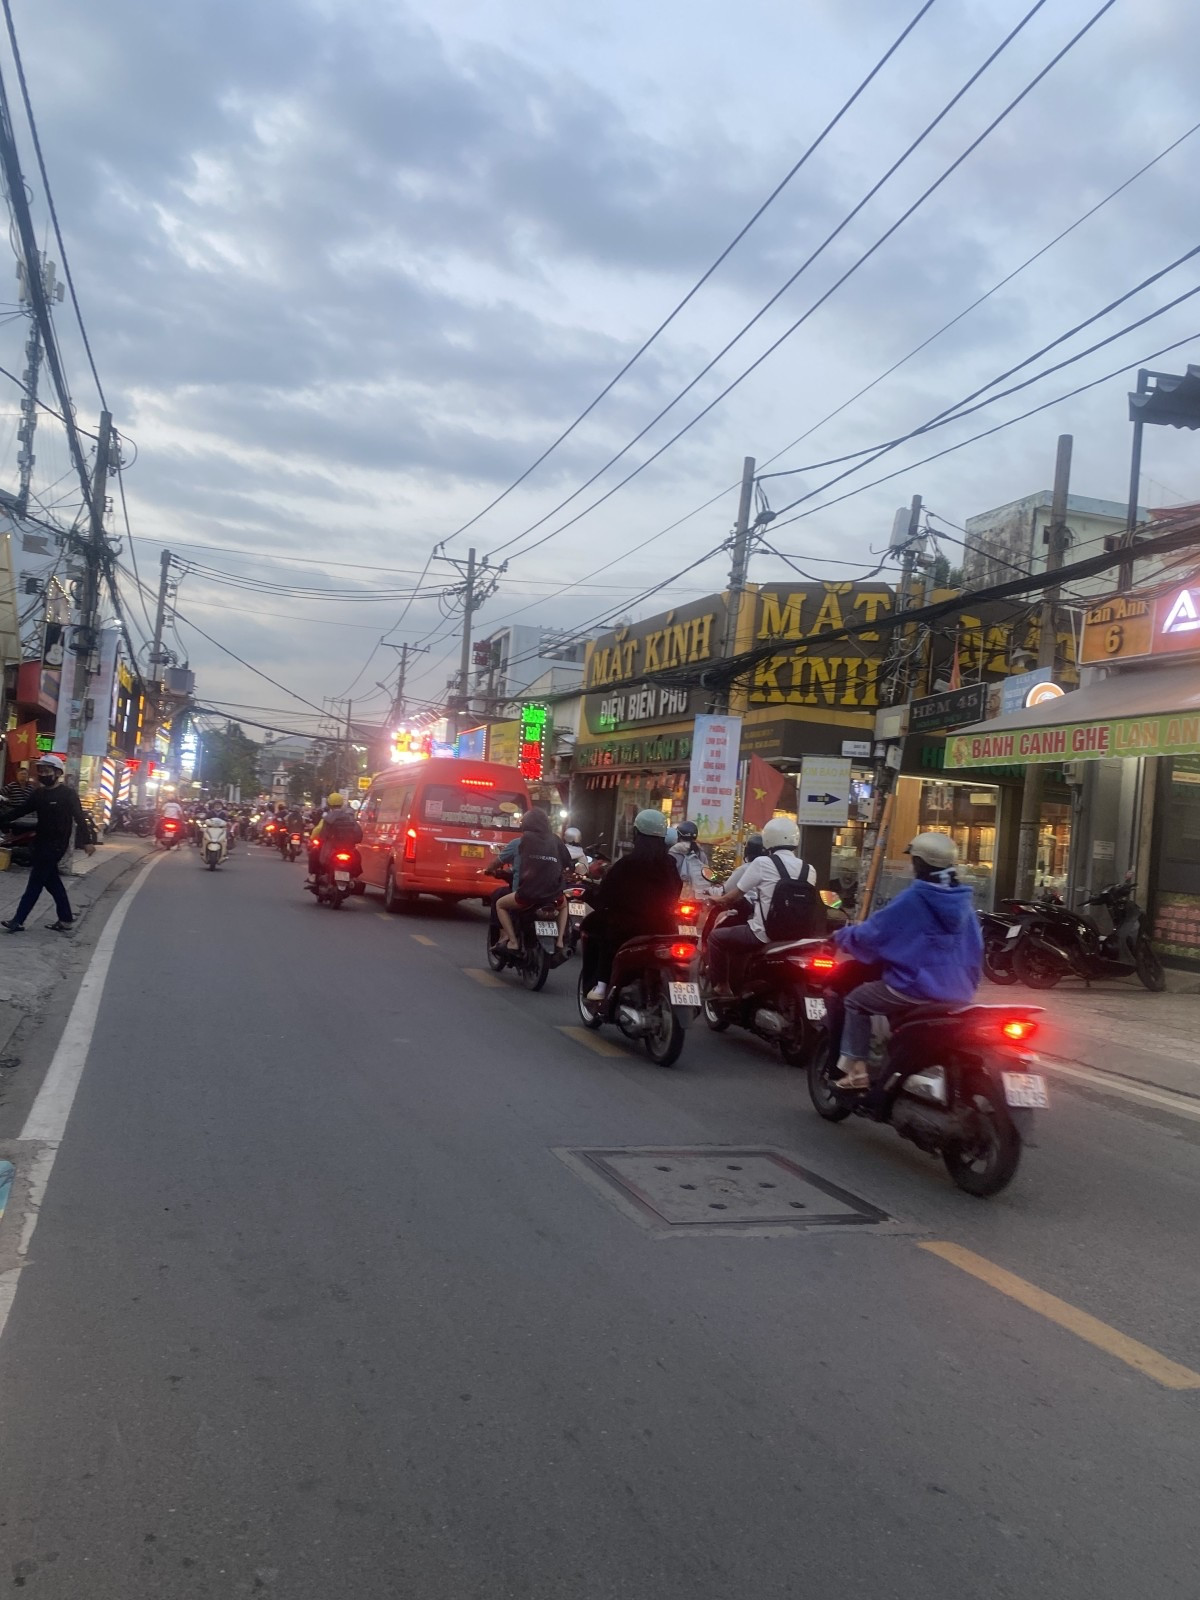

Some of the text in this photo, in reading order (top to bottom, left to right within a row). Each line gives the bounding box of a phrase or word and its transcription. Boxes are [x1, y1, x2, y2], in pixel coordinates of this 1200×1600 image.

[643, 610, 714, 673] KÍNH
[1105, 625, 1121, 654] 6
[627, 683, 656, 720] BIÊN
[956, 693, 978, 709] 45
[972, 734, 1014, 759] BÁNH
[1019, 730, 1066, 755] CANH
[1072, 725, 1110, 755] GHẸ
[1115, 720, 1160, 749] LAN
